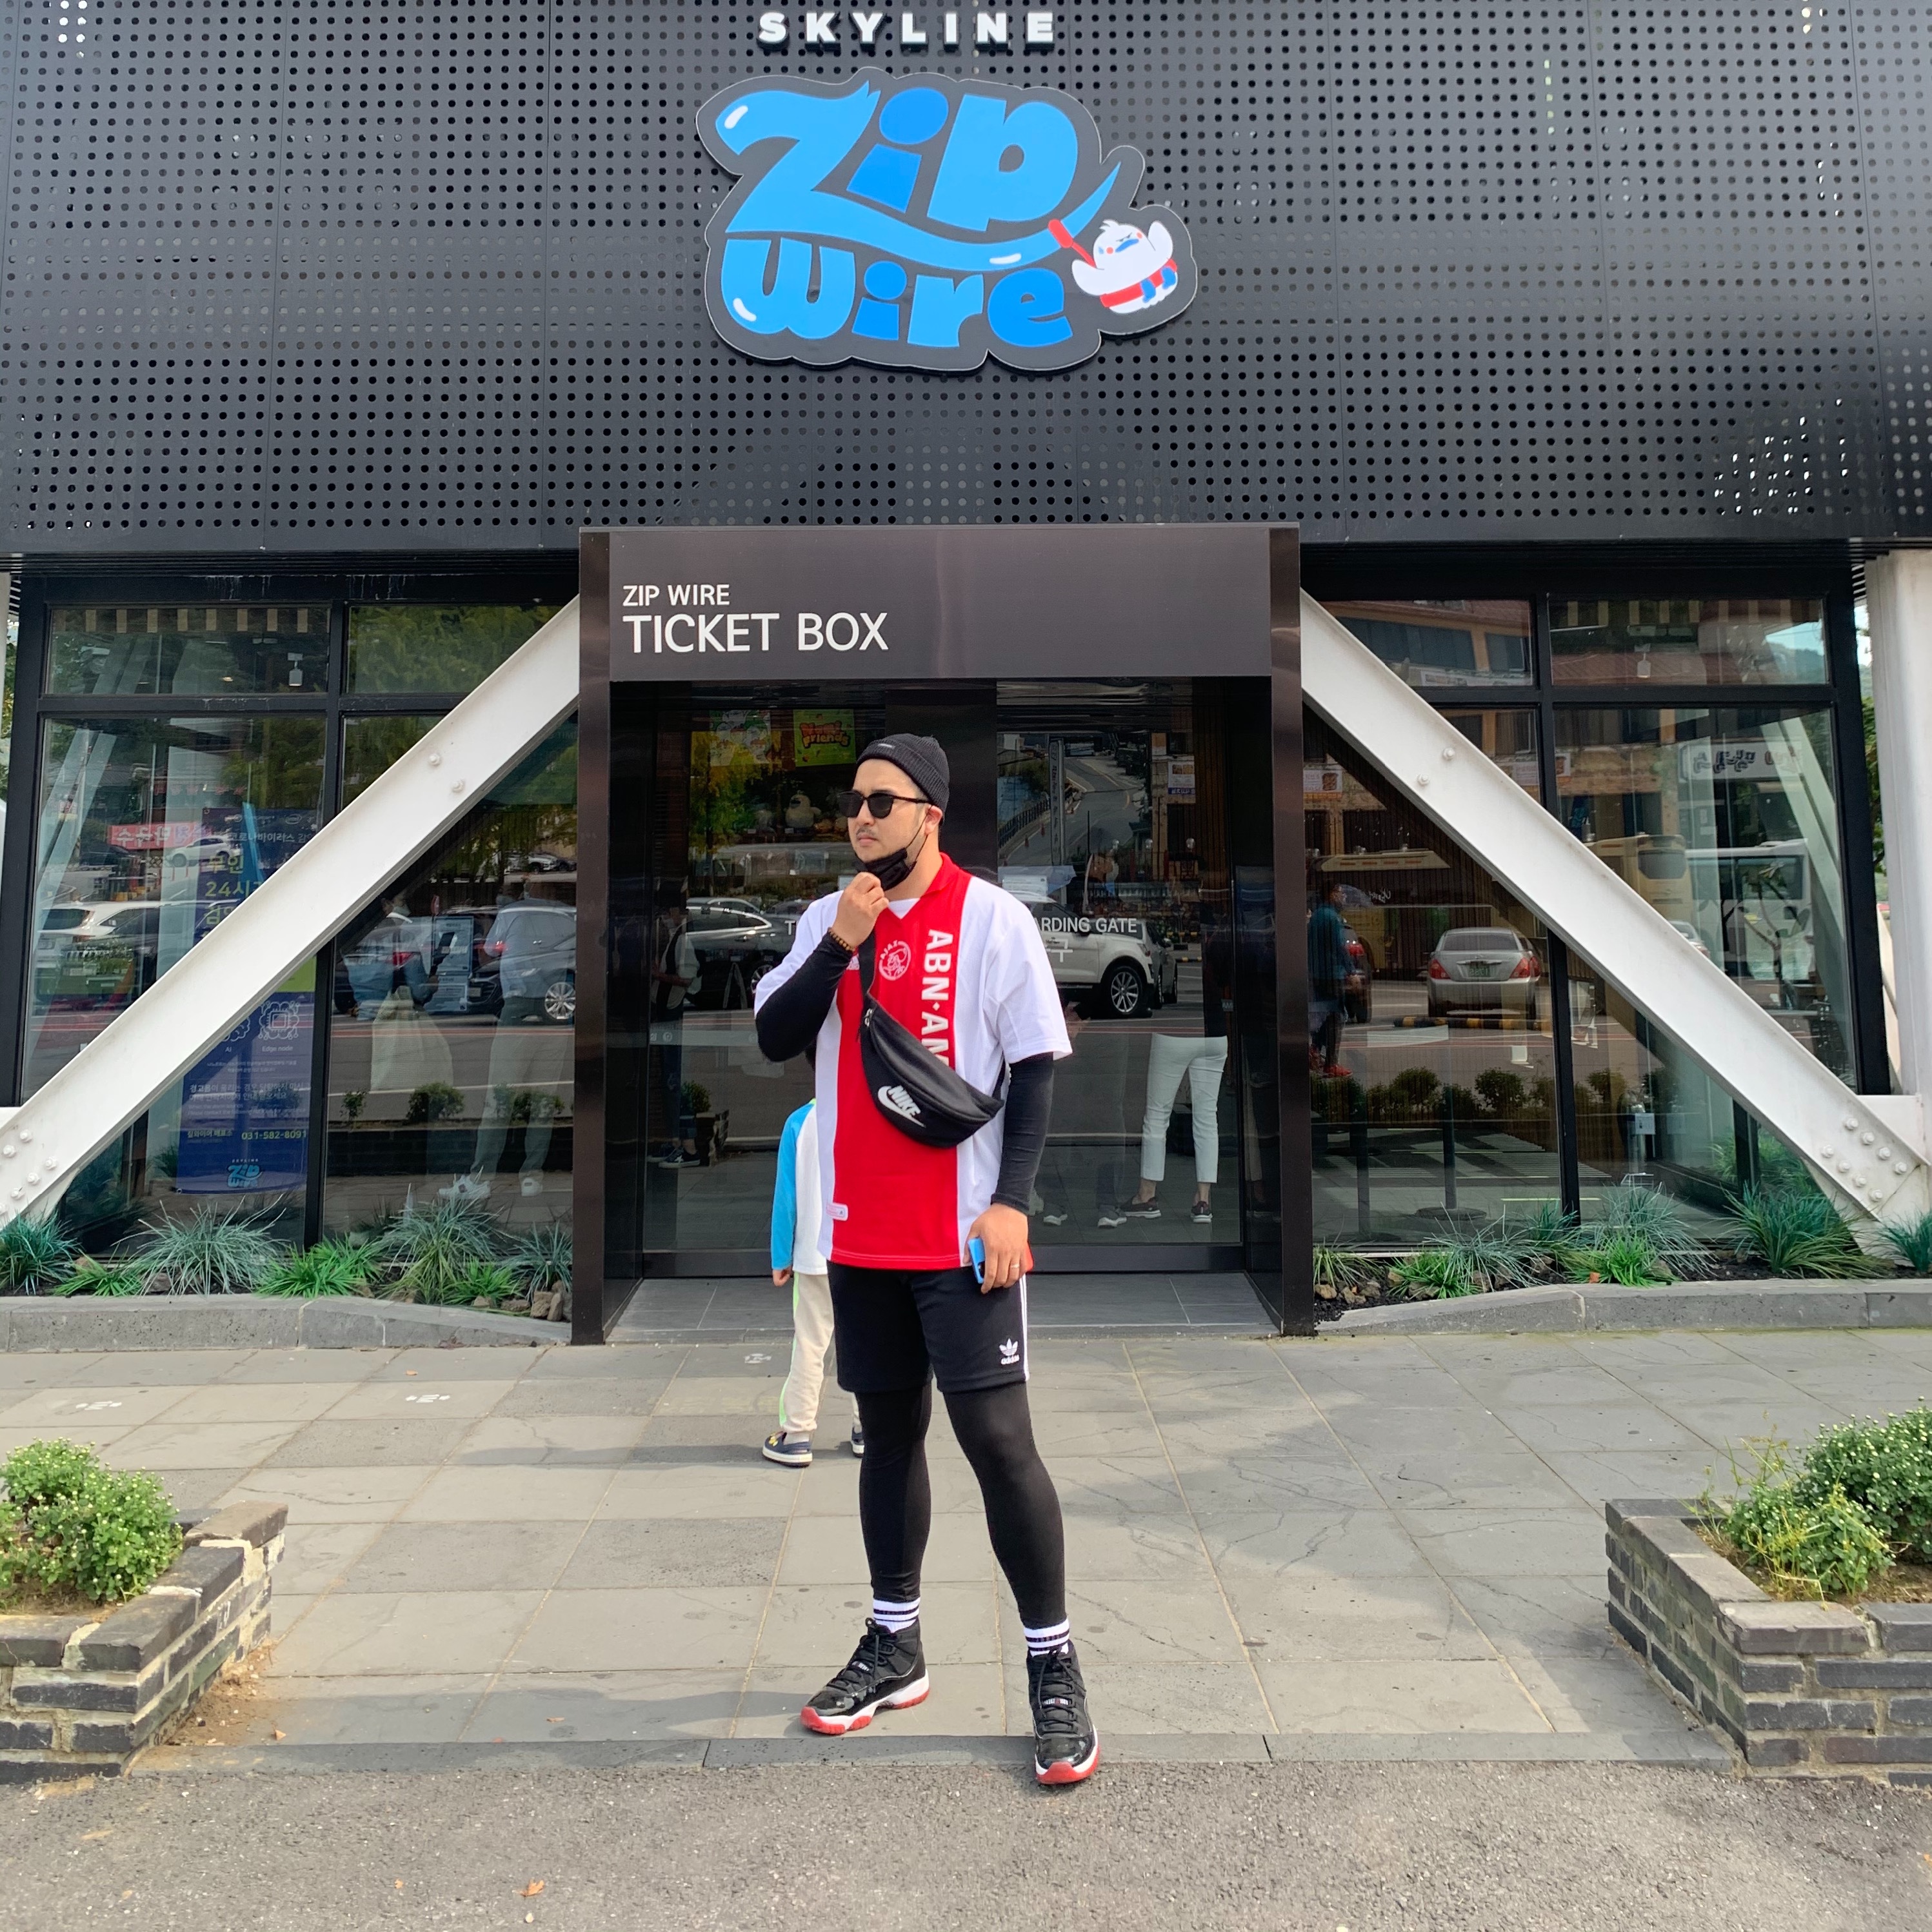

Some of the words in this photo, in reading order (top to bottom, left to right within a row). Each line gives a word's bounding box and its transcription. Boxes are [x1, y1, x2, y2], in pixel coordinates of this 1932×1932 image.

[758, 12, 1056, 48] SKYLINE
[721, 238, 1073, 348] wire
[622, 584, 660, 606] ZIP
[668, 583, 730, 606] WIRE
[622, 612, 781, 653] TICKET
[798, 612, 889, 651] BOX
[1095, 917, 1137, 933] GATE
[880, 940, 899, 960] AJAX
[888, 1084, 921, 1115] NIKE
[241, 1130, 307, 1140] 031-582-8091
